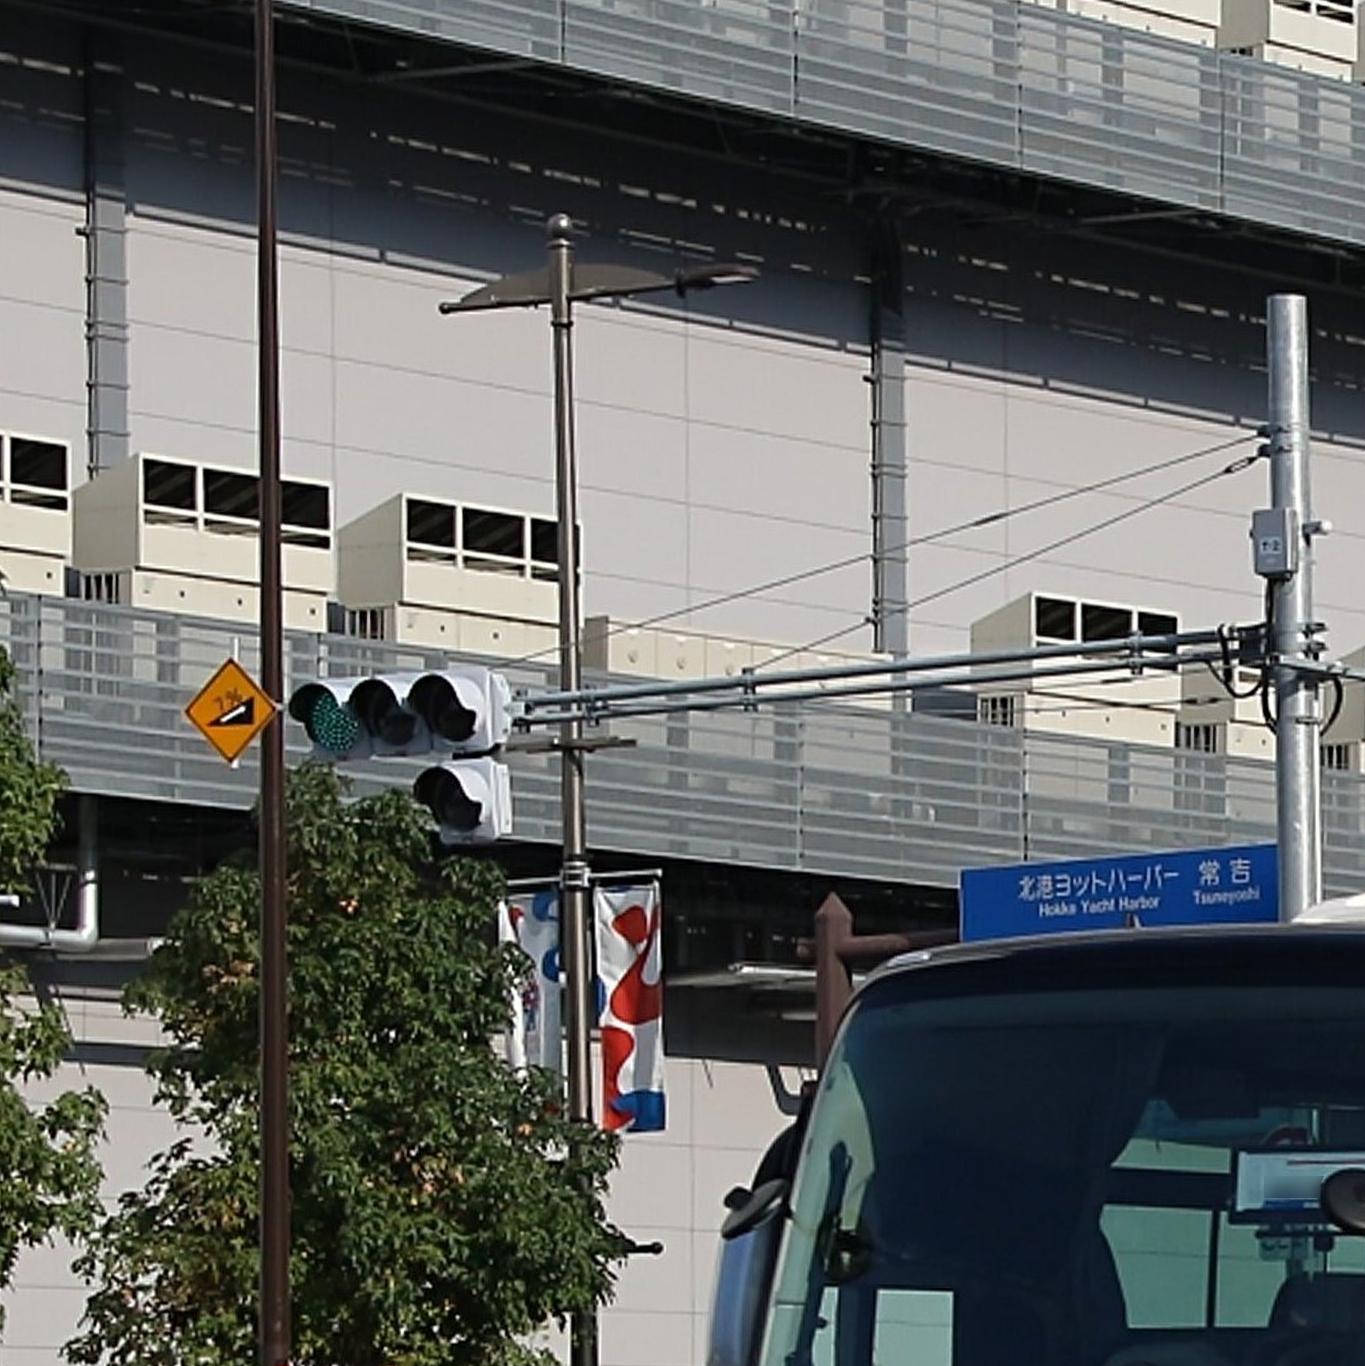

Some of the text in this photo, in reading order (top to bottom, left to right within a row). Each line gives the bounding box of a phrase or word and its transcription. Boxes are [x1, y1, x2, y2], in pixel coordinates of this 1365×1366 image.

[1018, 864, 1180, 900] 北港ヨットハーバー
[1081, 896, 1116, 914] Yacht
[1118, 895, 1161, 912] Harbor
[1193, 885, 1261, 906] Tsuneyoshi
